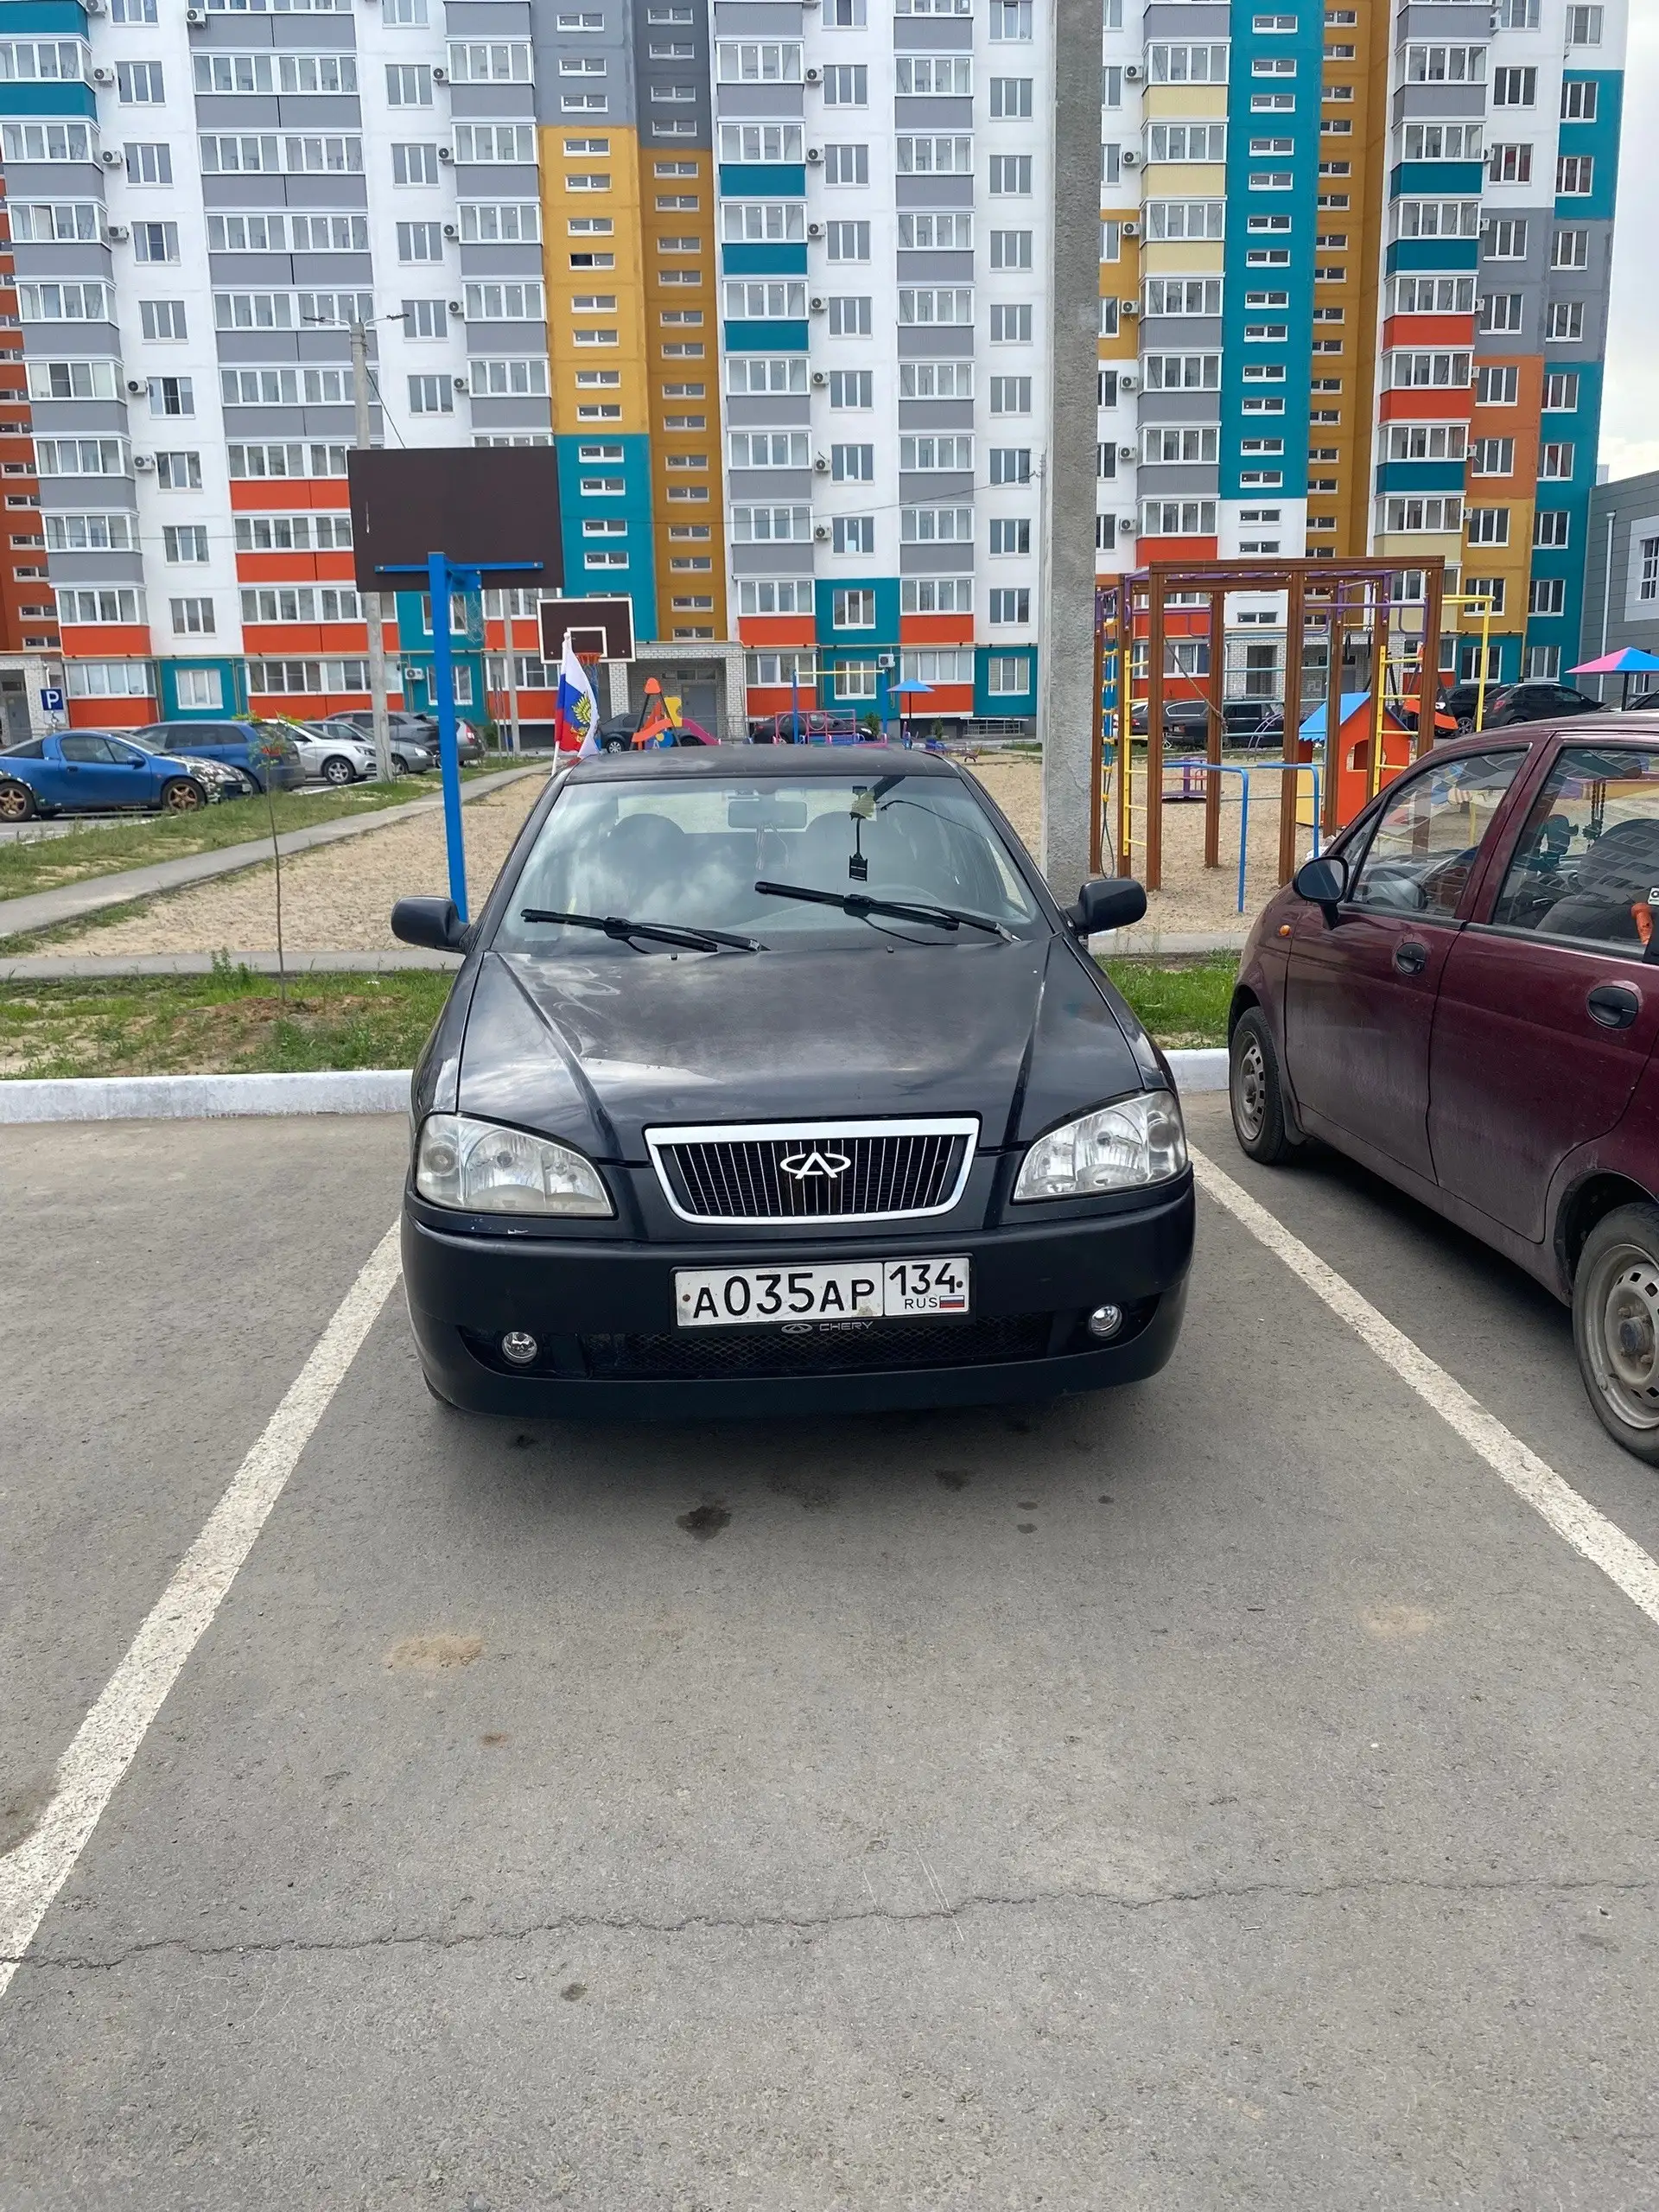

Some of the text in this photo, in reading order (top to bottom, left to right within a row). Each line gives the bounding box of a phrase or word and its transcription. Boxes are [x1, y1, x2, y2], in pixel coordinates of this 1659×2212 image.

[46, 690, 60, 709] P
[889, 1262, 956, 1296] 134
[904, 1297, 938, 1309] RUS
[819, 1321, 874, 1332] CHERY
